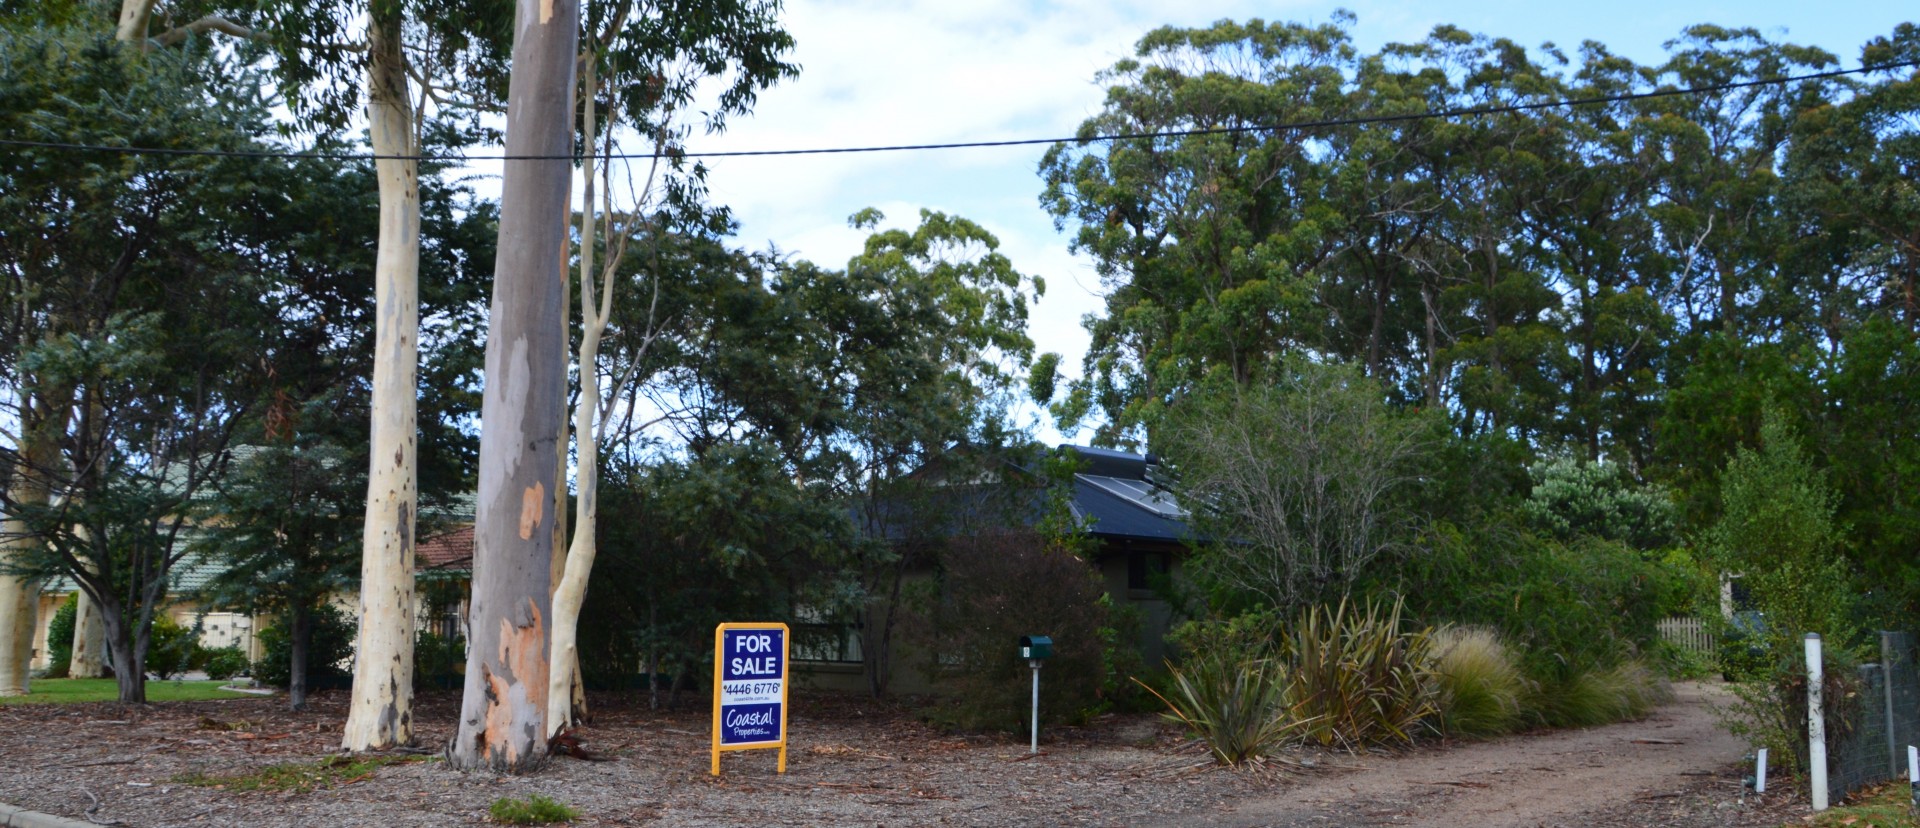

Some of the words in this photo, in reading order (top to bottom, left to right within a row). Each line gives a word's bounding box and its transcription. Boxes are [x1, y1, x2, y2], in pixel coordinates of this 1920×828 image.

[736, 635, 771, 653] FOR
[731, 657, 776, 675] SALE
[726, 684, 751, 695] 4446
[754, 683, 778, 694] 6776
[727, 707, 773, 727] Coastal
[734, 727, 764, 738] Properties
